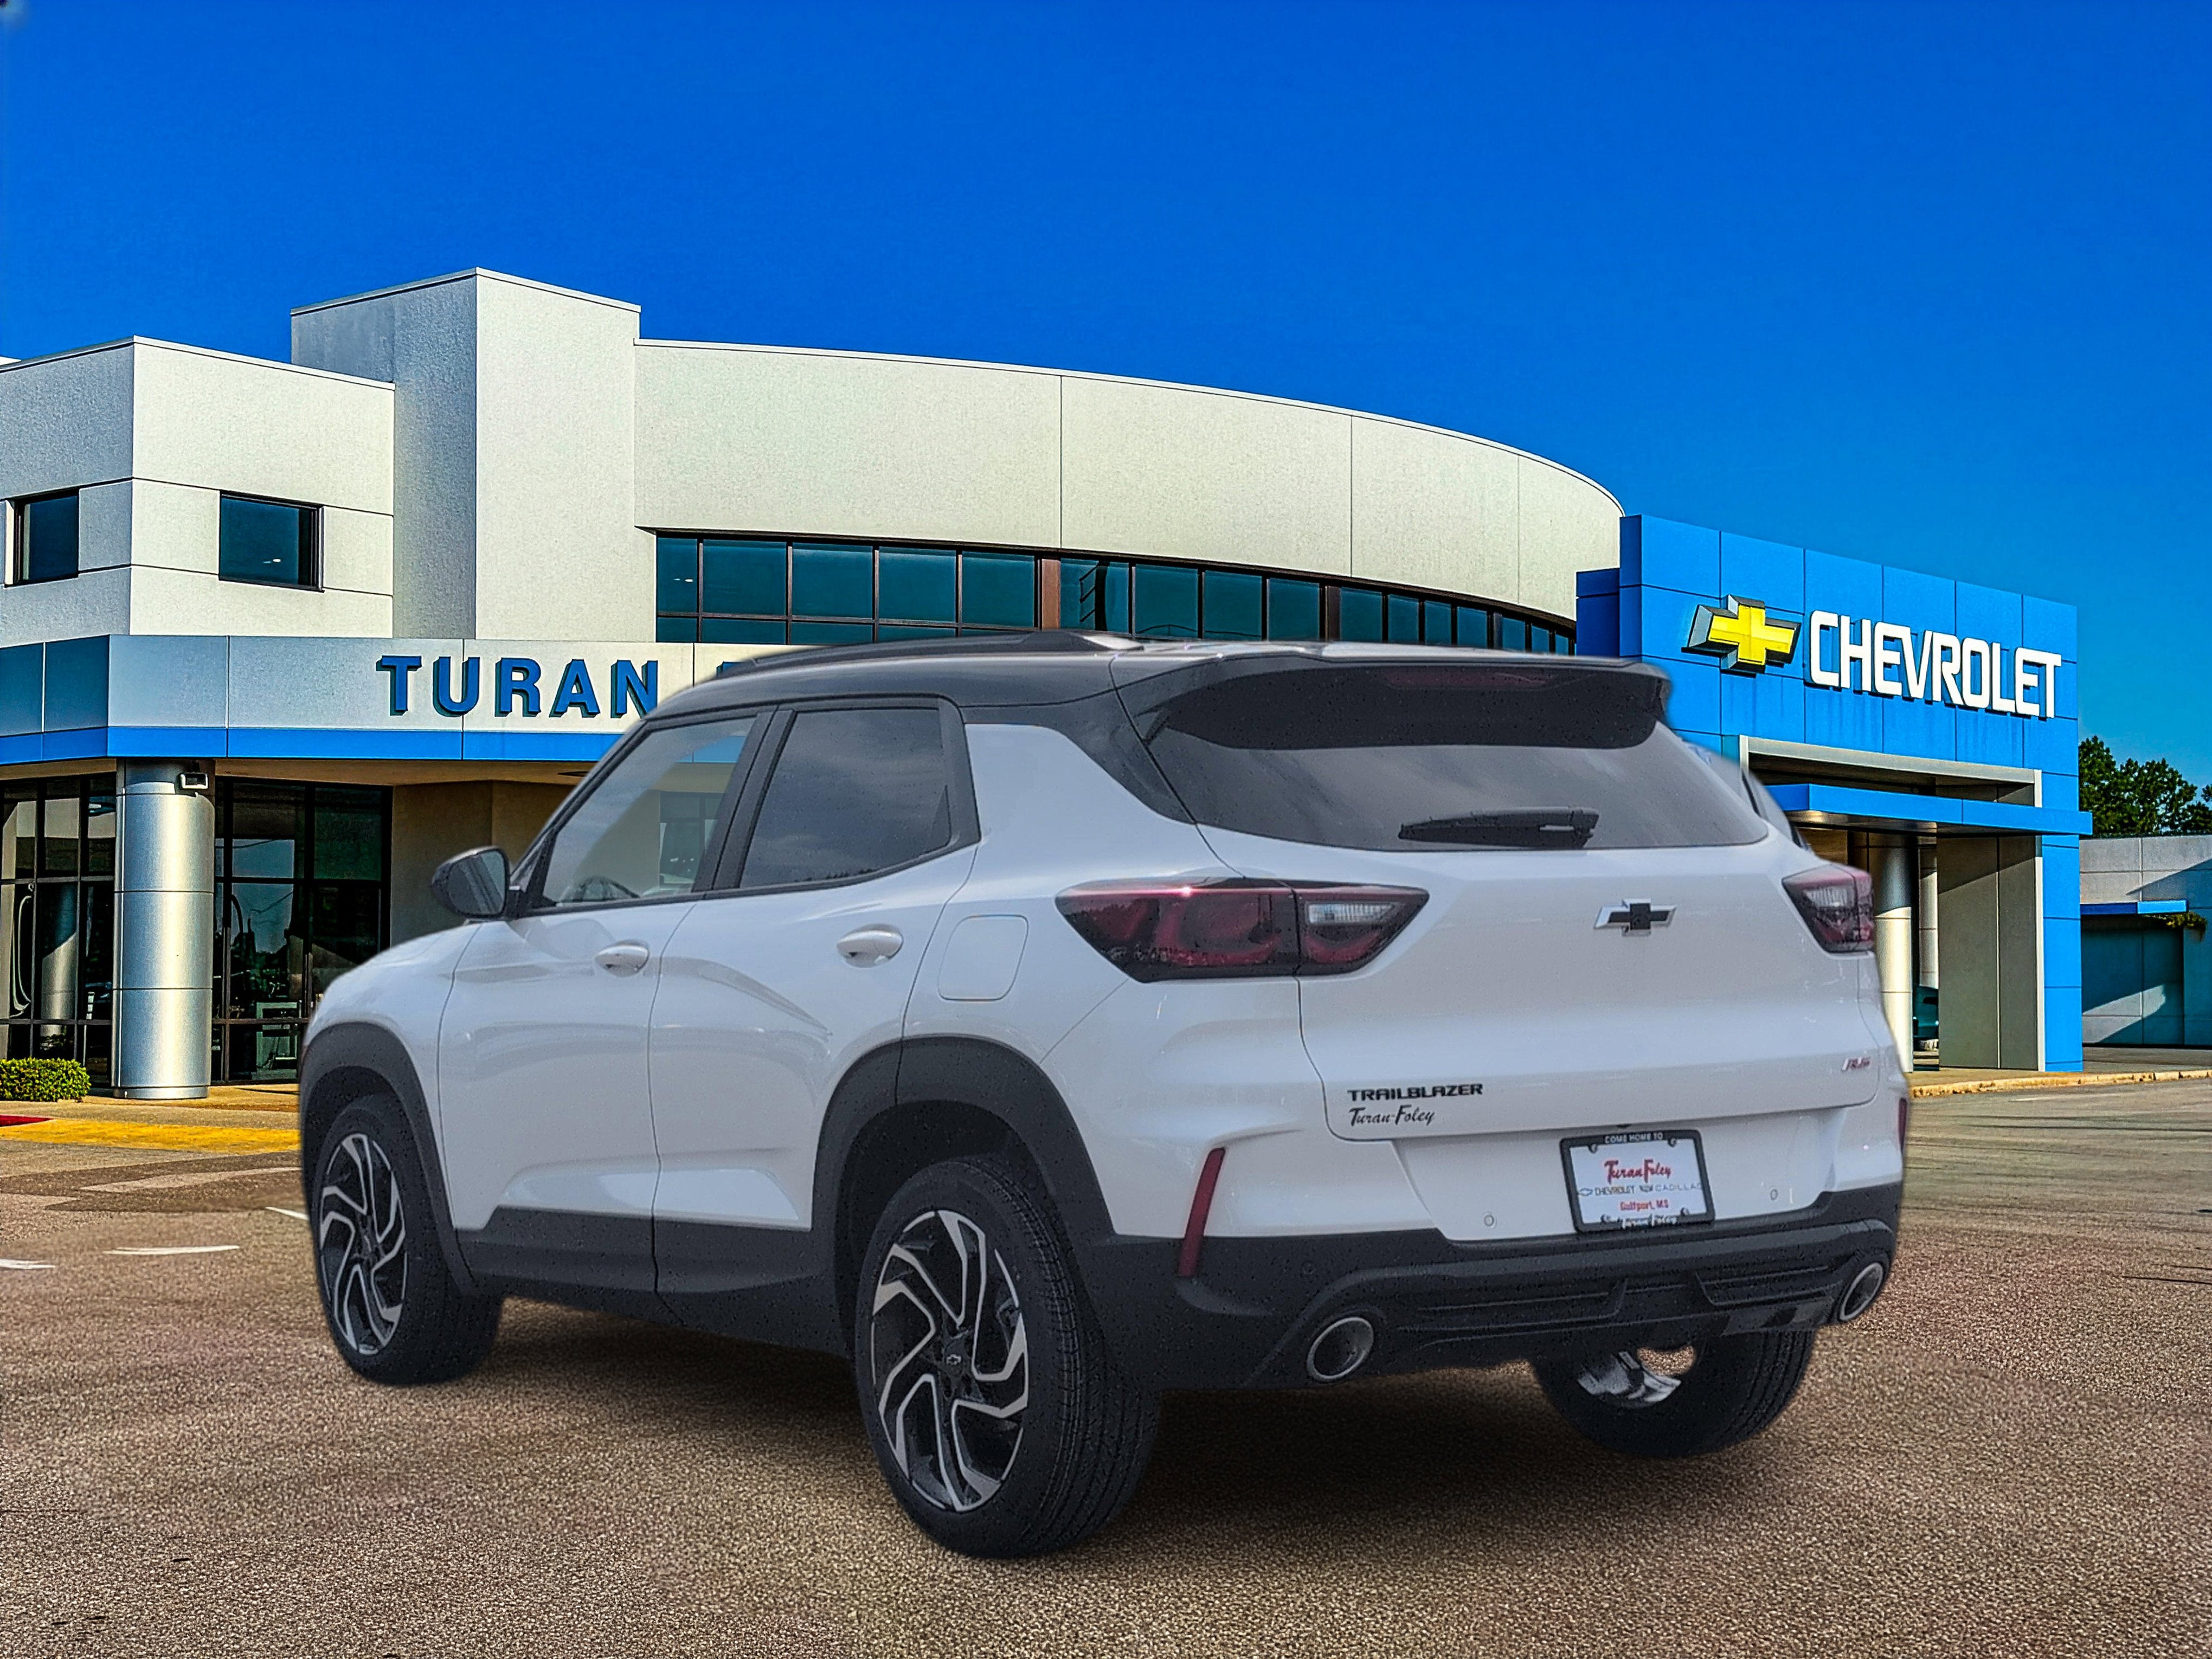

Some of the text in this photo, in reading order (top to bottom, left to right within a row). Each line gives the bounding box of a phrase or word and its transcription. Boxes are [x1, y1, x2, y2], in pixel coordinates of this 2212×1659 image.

[1809, 610, 2061, 718] CHEVROLET
[376, 655, 658, 718] TURAN
[1347, 1084, 1483, 1101] TRAILBLAZER
[1605, 1135, 1627, 1143] COME
[1652, 1132, 1663, 1140] TO
